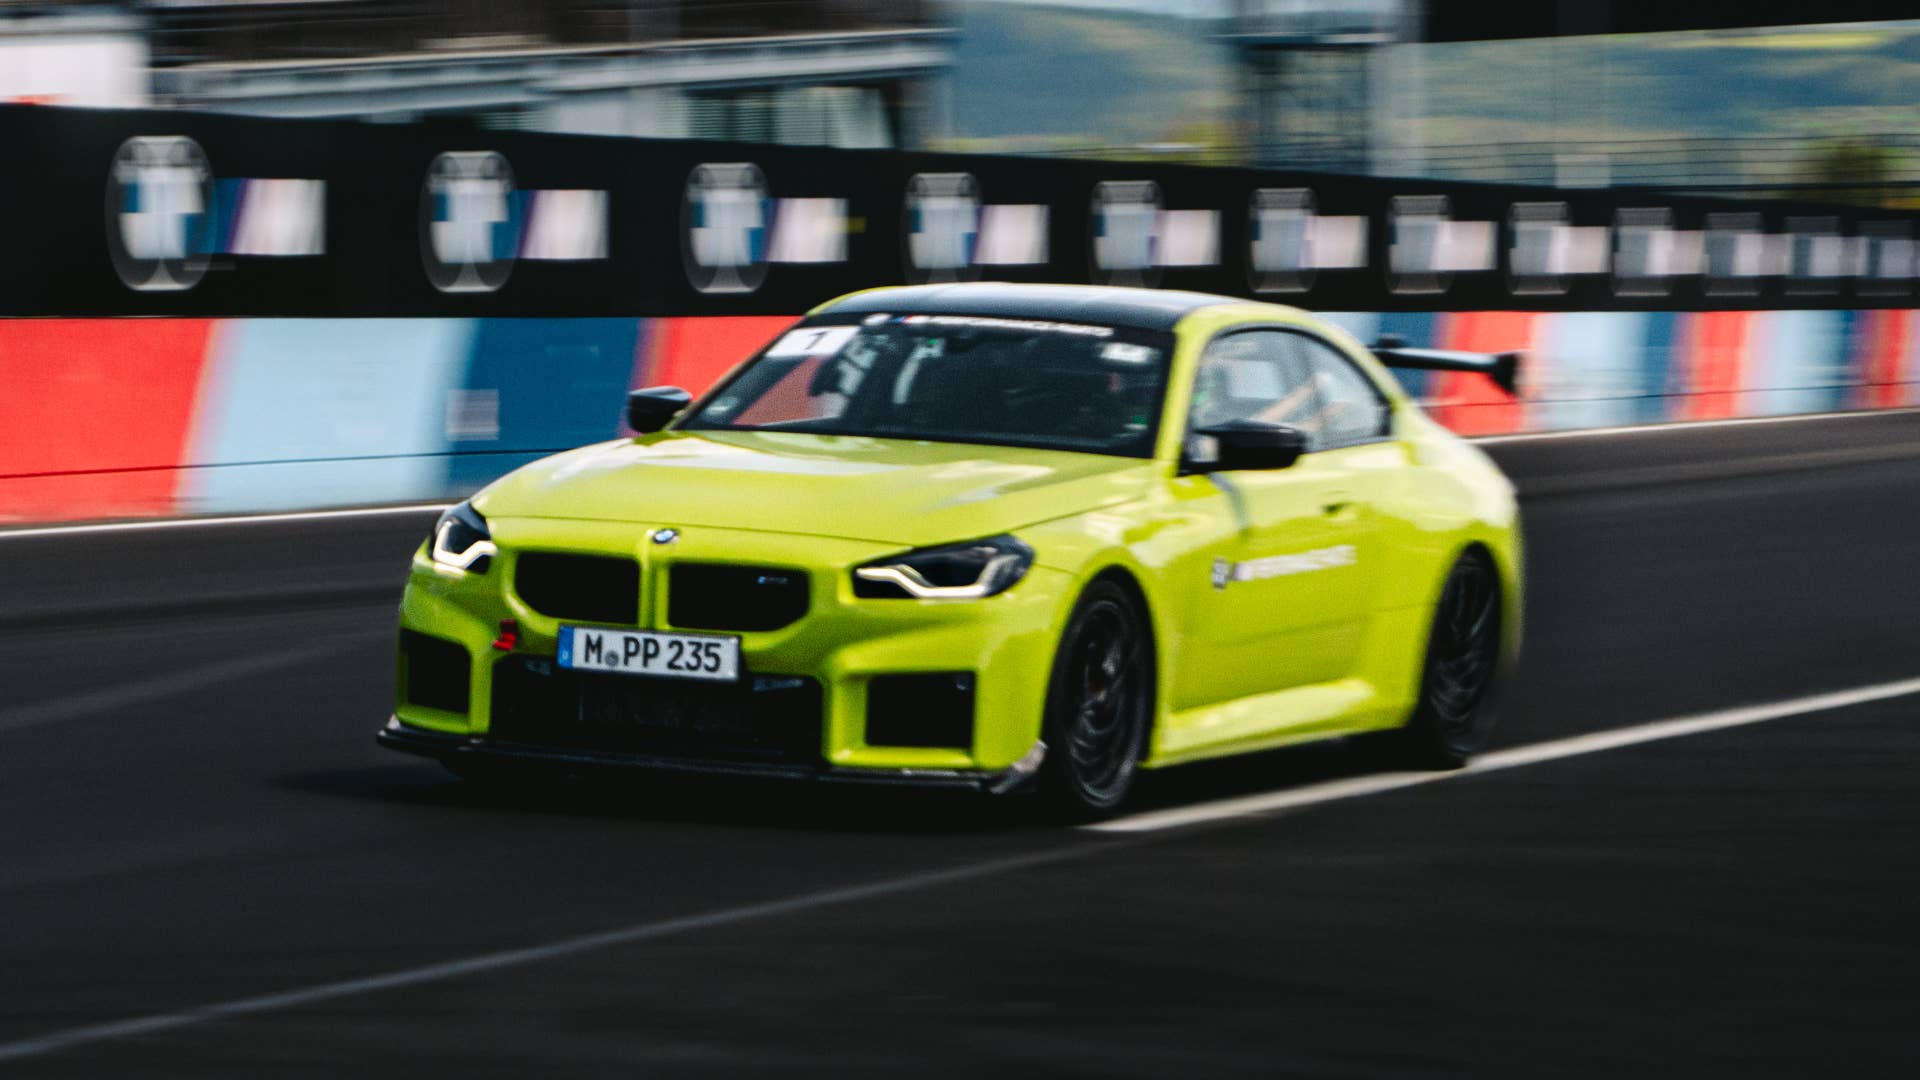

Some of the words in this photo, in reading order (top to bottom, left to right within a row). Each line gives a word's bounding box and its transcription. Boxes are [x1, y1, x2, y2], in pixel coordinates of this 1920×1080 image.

[584, 633, 603, 663] M
[623, 636, 660, 668] PP
[667, 640, 721, 672] 235
